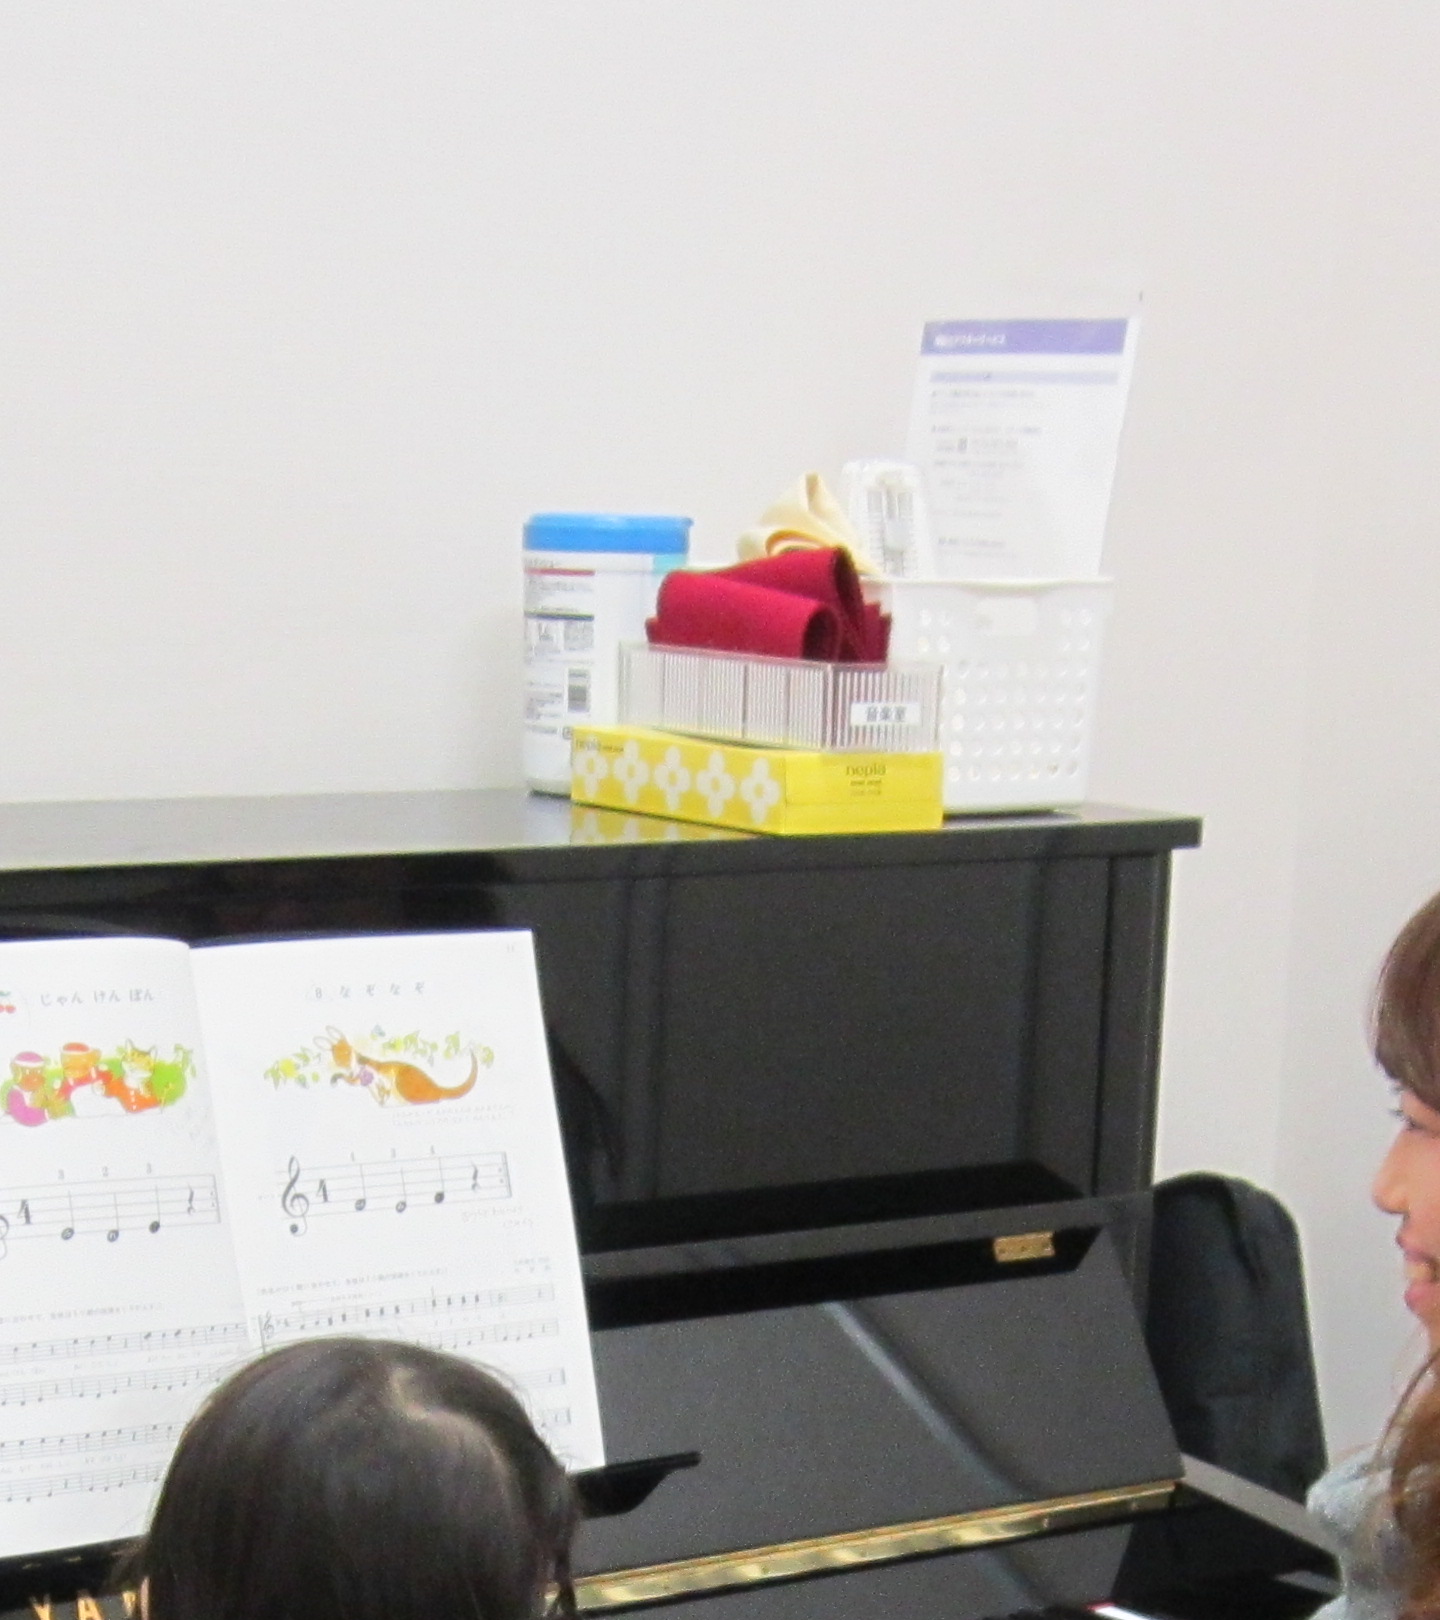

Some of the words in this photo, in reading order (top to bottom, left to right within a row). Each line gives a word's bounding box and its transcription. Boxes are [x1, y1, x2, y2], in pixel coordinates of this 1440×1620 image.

[40, 989, 84, 1007] じゃん
[92, 988, 122, 1004] けん
